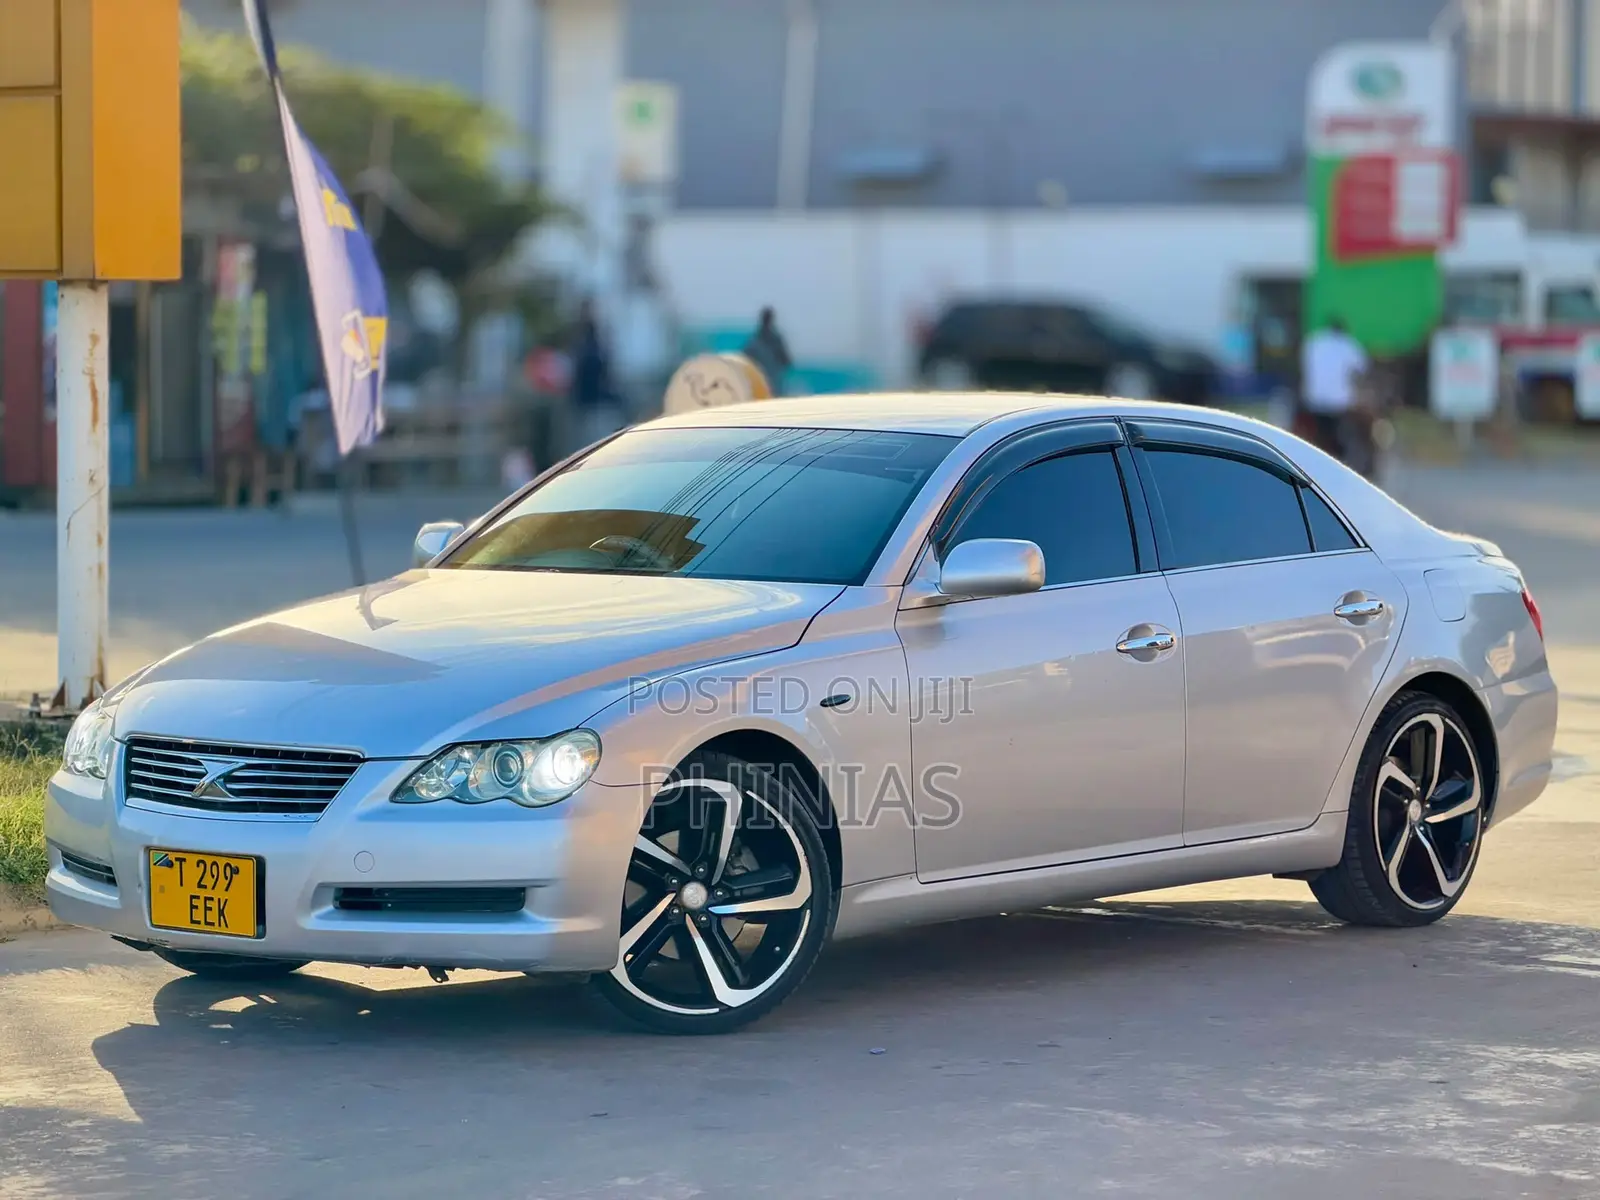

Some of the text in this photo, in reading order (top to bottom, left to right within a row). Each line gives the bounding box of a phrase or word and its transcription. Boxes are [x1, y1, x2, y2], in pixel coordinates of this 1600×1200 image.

[174, 857, 233, 891] T 299
[189, 894, 228, 928] EEK
